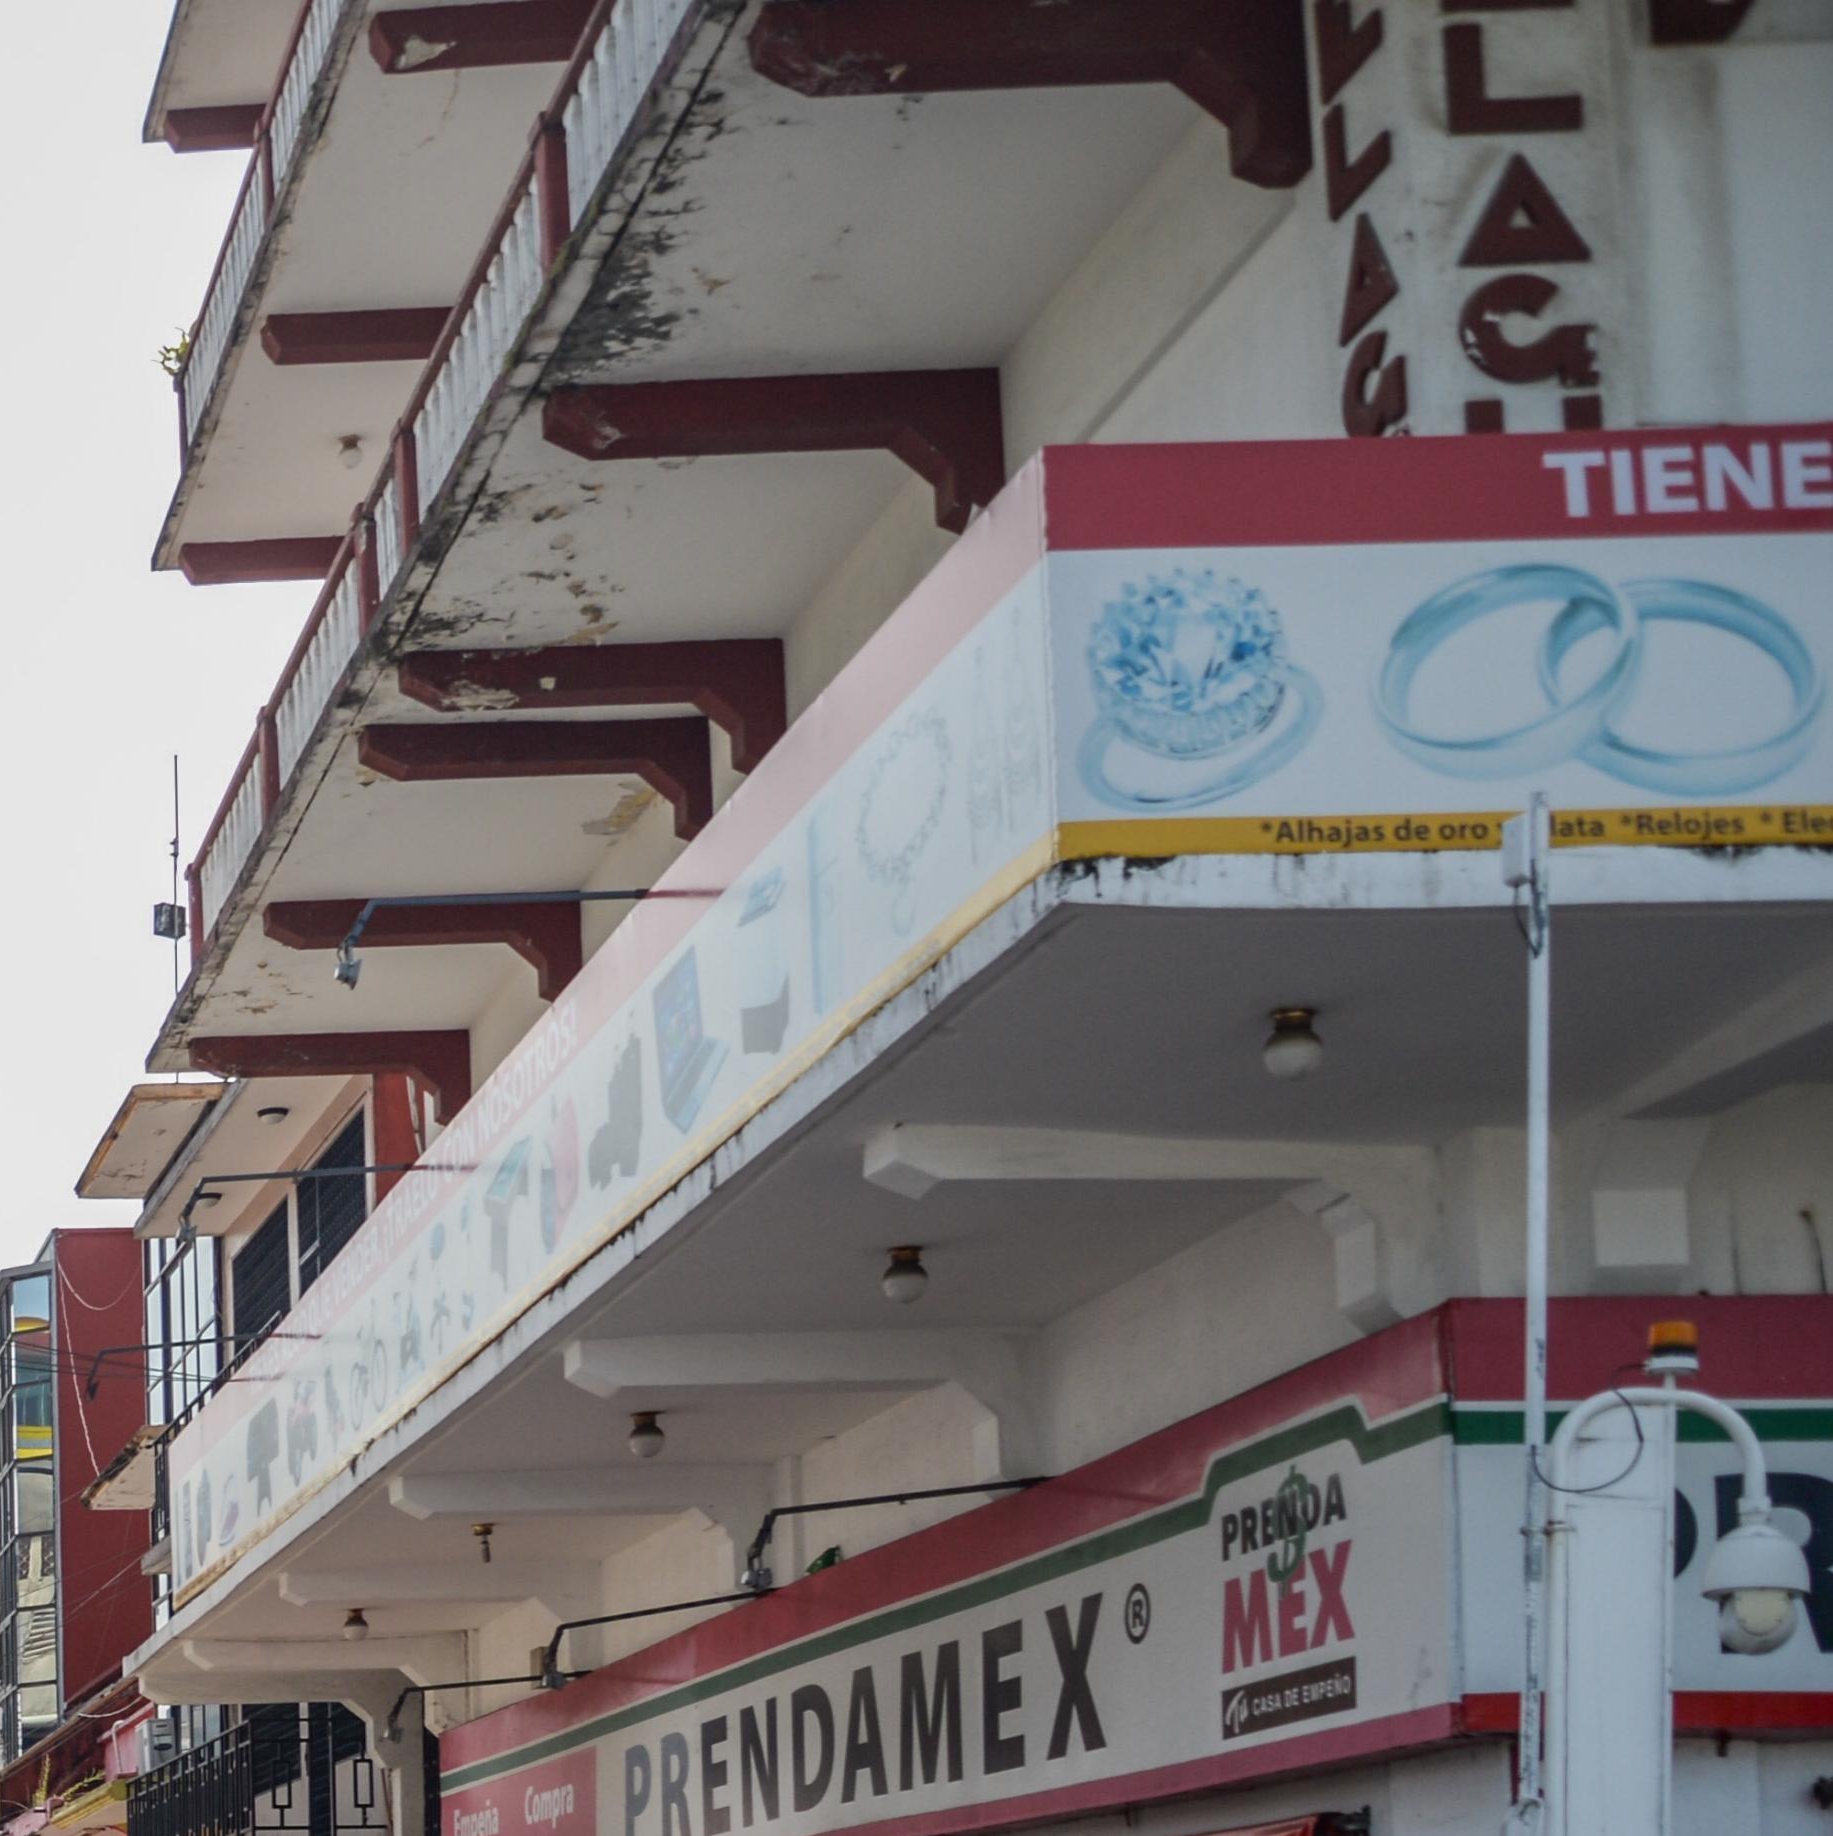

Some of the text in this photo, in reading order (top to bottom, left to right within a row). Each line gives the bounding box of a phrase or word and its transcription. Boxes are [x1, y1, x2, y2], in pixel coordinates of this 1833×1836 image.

[1543, 441, 1833, 518] TIENE
[1399, 814, 1430, 842] de
[1438, 820, 1487, 842] oro
[1549, 812, 1605, 839] lata
[1782, 808, 1833, 834] Ele
[1221, 1472, 1347, 1562] PRENDA
[1221, 1538, 1356, 1675] MEX
[1252, 1694, 1282, 1717] CASA
[1284, 1690, 1300, 1708] DE
[1302, 1674, 1352, 1704] EMPEÑO
[524, 1783, 574, 1830] Compra
